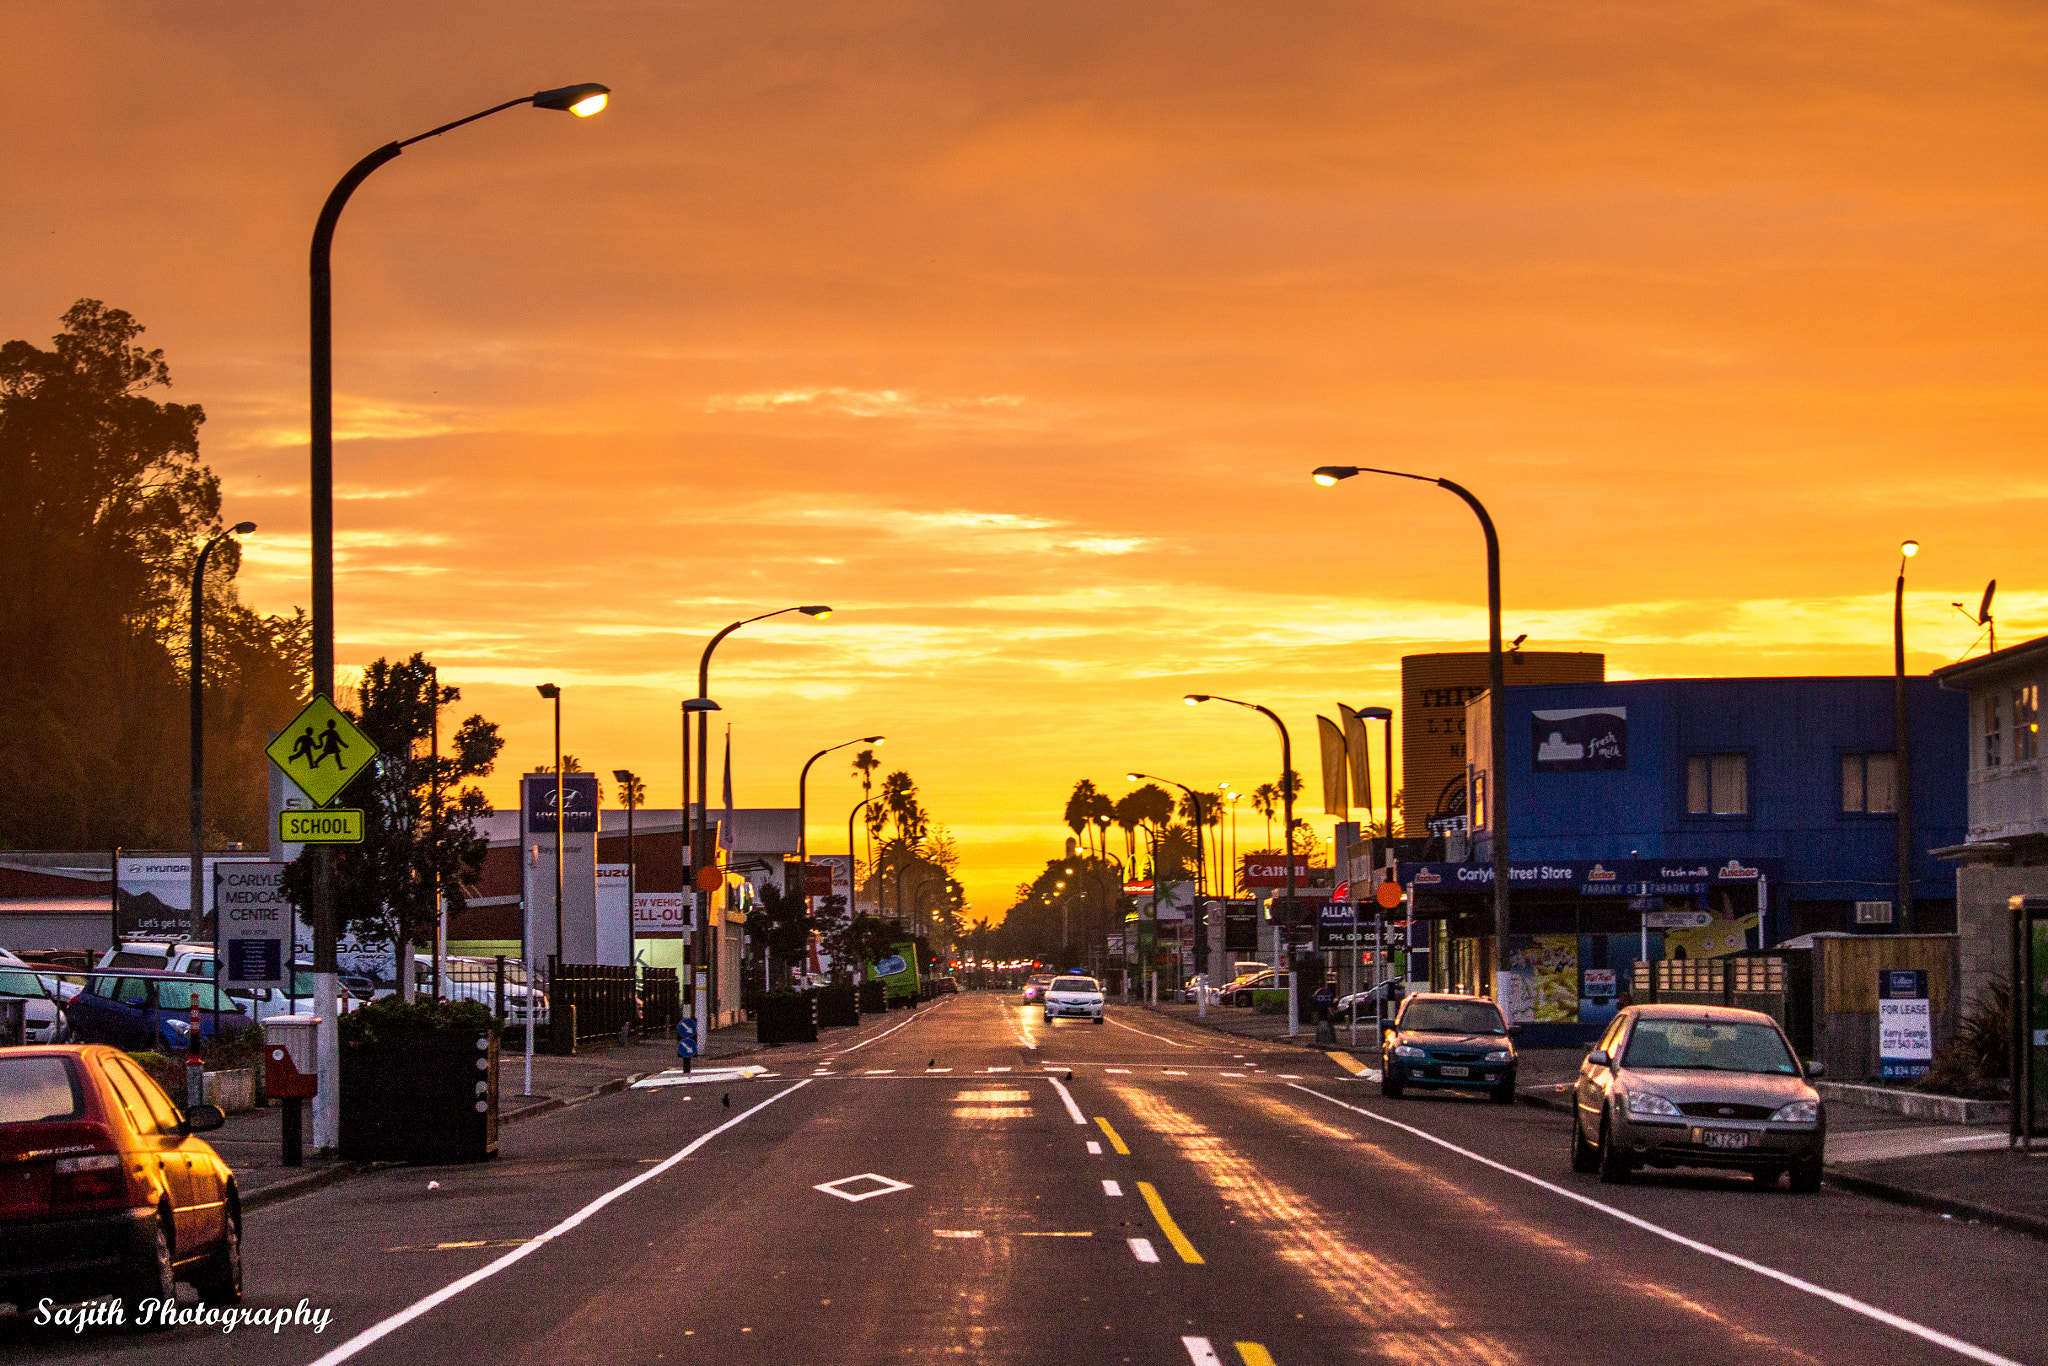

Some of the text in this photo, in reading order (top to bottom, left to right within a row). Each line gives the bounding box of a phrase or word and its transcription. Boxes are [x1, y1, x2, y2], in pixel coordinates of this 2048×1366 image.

[1588, 731, 1617, 757] fresh
[1599, 744, 1622, 758] milk
[536, 811, 592, 820] HYNDAI
[291, 818, 352, 834] SCHOOL
[1508, 867, 1538, 880] treet
[1541, 866, 1573, 880] Store
[1661, 866, 1709, 877] fresh milk
[1719, 867, 1758, 878] Anchor
[228, 874, 281, 887] CARLYLE
[1582, 884, 1640, 894] FARADAY ST
[1650, 883, 1706, 893] FARADAY ST
[226, 891, 283, 904] MEDICAL
[230, 908, 279, 921] CENTRE
[138, 918, 191, 930] Let's get los
[1383, 933, 1405, 941] 772
[292, 943, 391, 953] OUBACK
[1882, 1005, 1928, 1015] FOR LEASE
